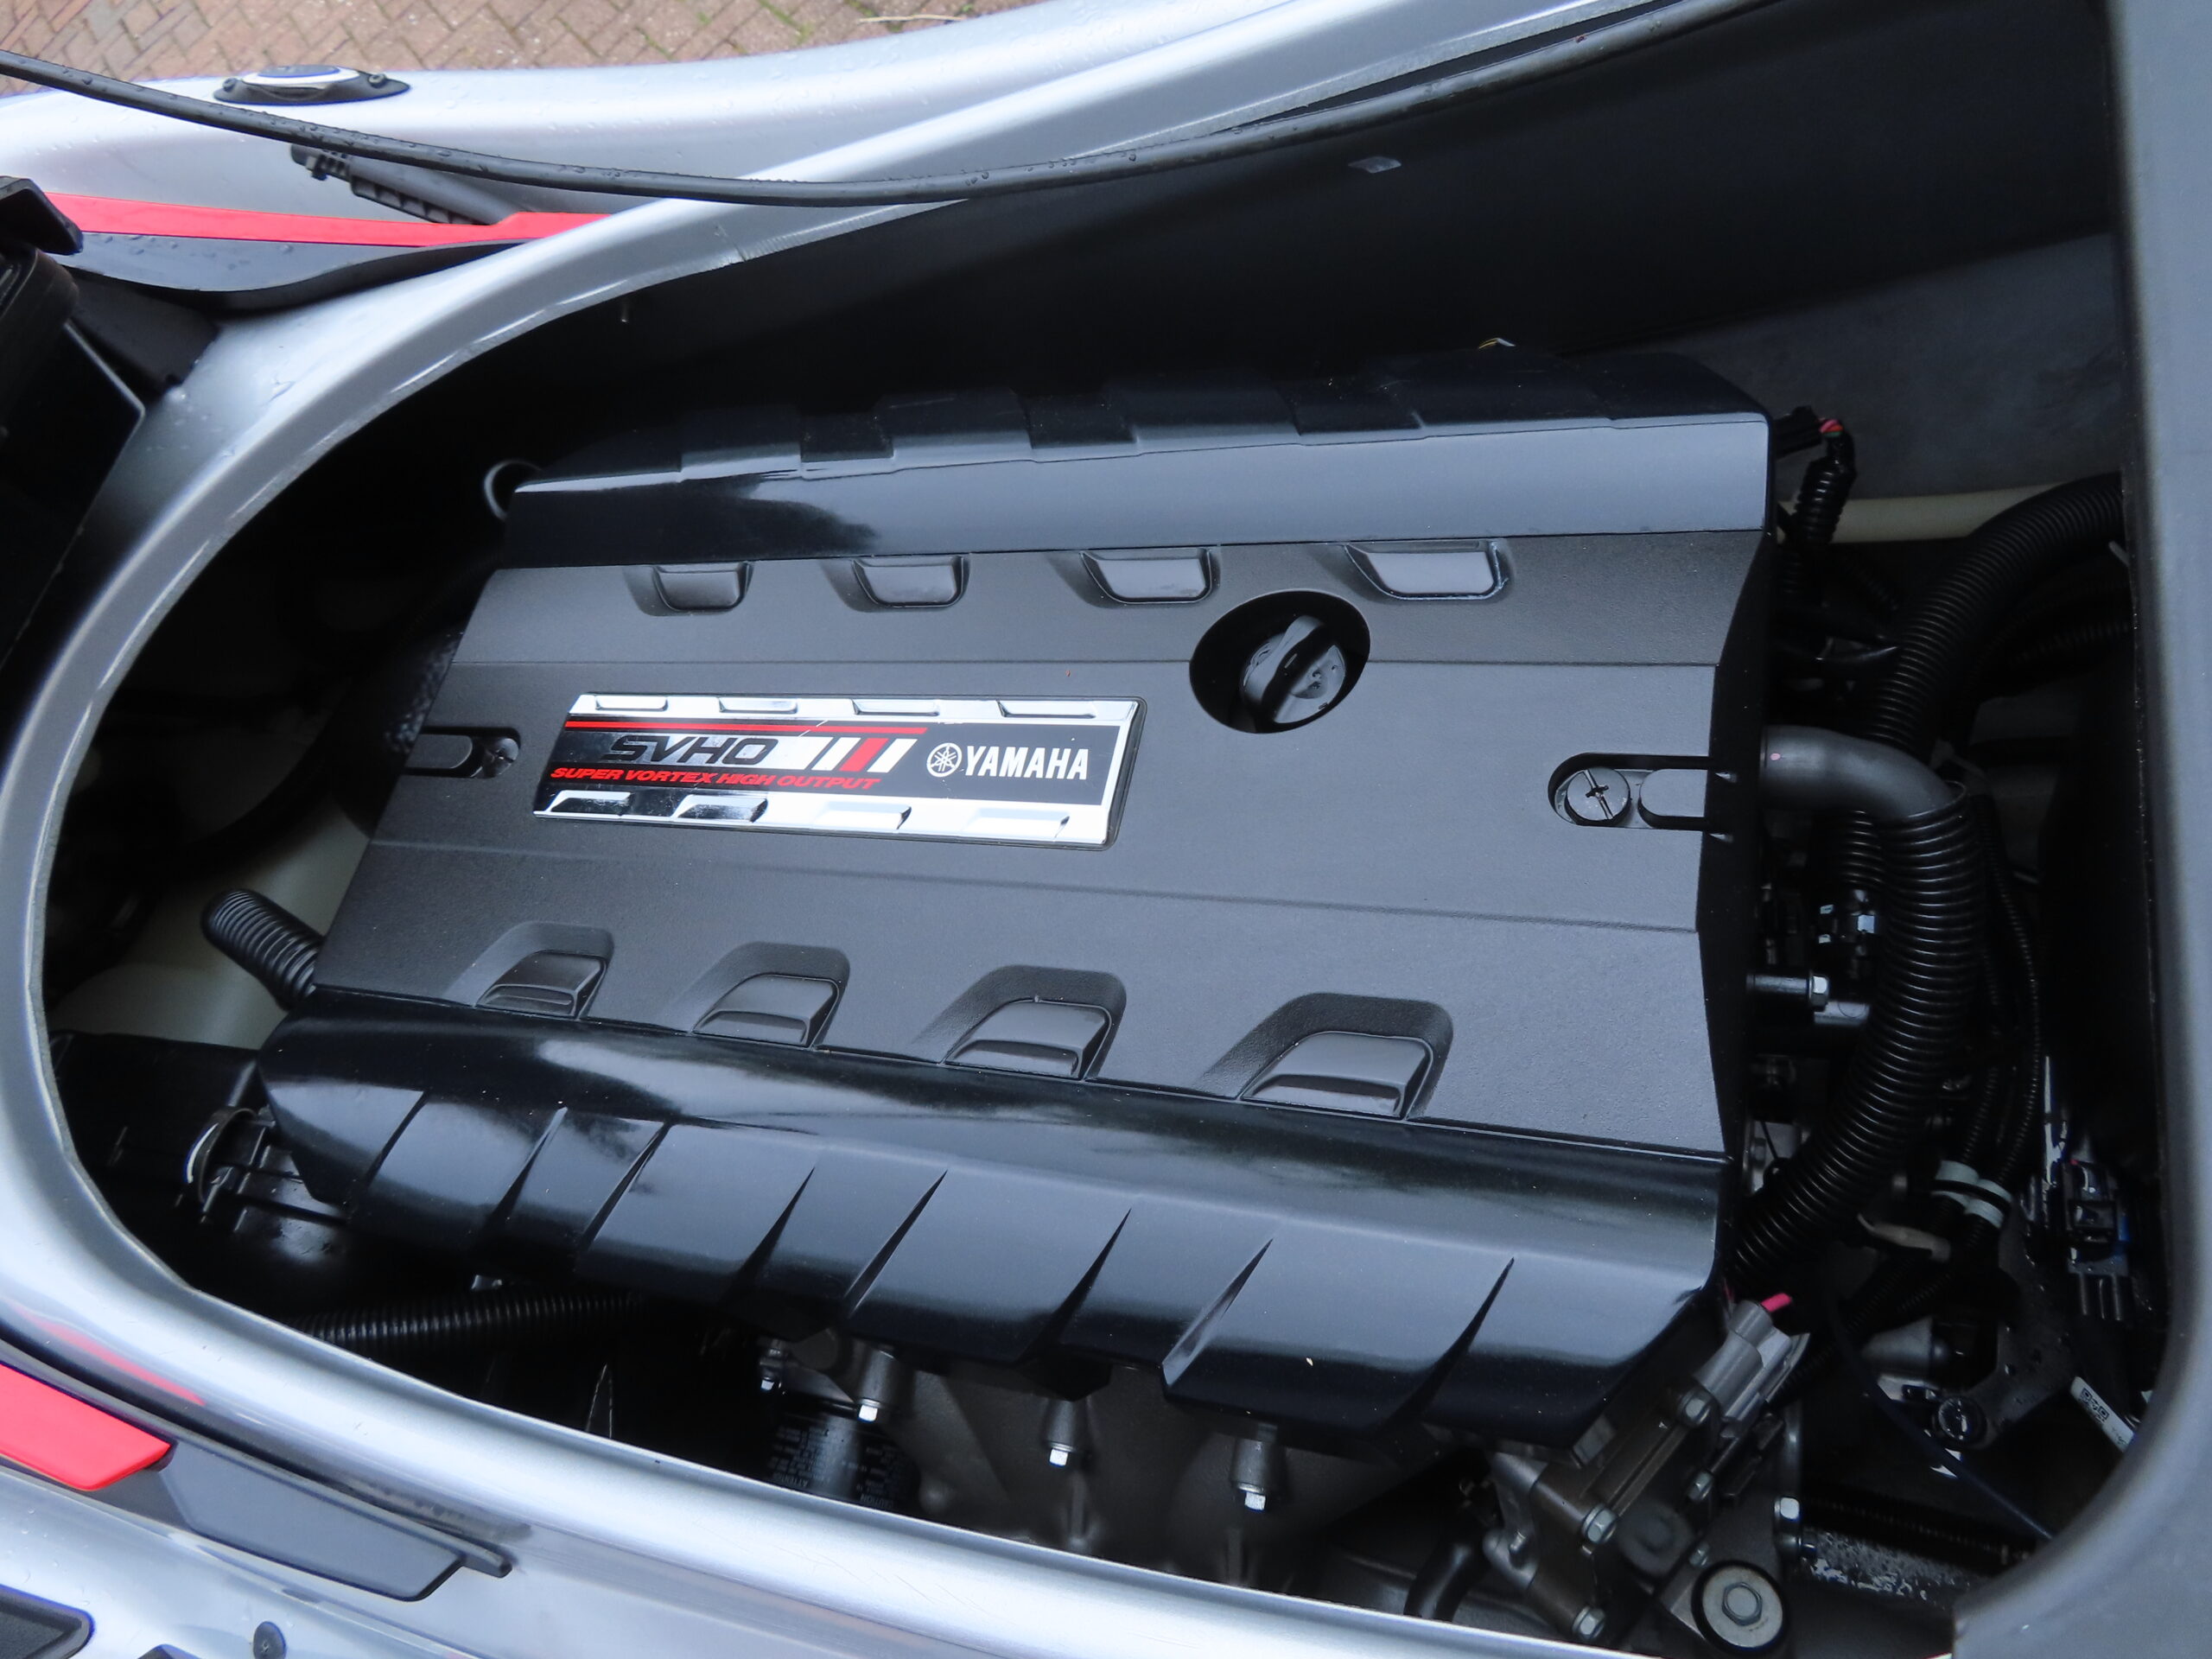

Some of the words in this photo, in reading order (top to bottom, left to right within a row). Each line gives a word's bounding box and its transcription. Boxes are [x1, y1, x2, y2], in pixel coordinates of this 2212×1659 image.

[604, 735, 779, 765] SVHO
[965, 746, 1089, 780] YAMAHA
[550, 767, 624, 779] SUPER
[625, 770, 718, 784] VORTEX
[715, 772, 776, 785] HIGH
[777, 775, 880, 790] OUTPUT
